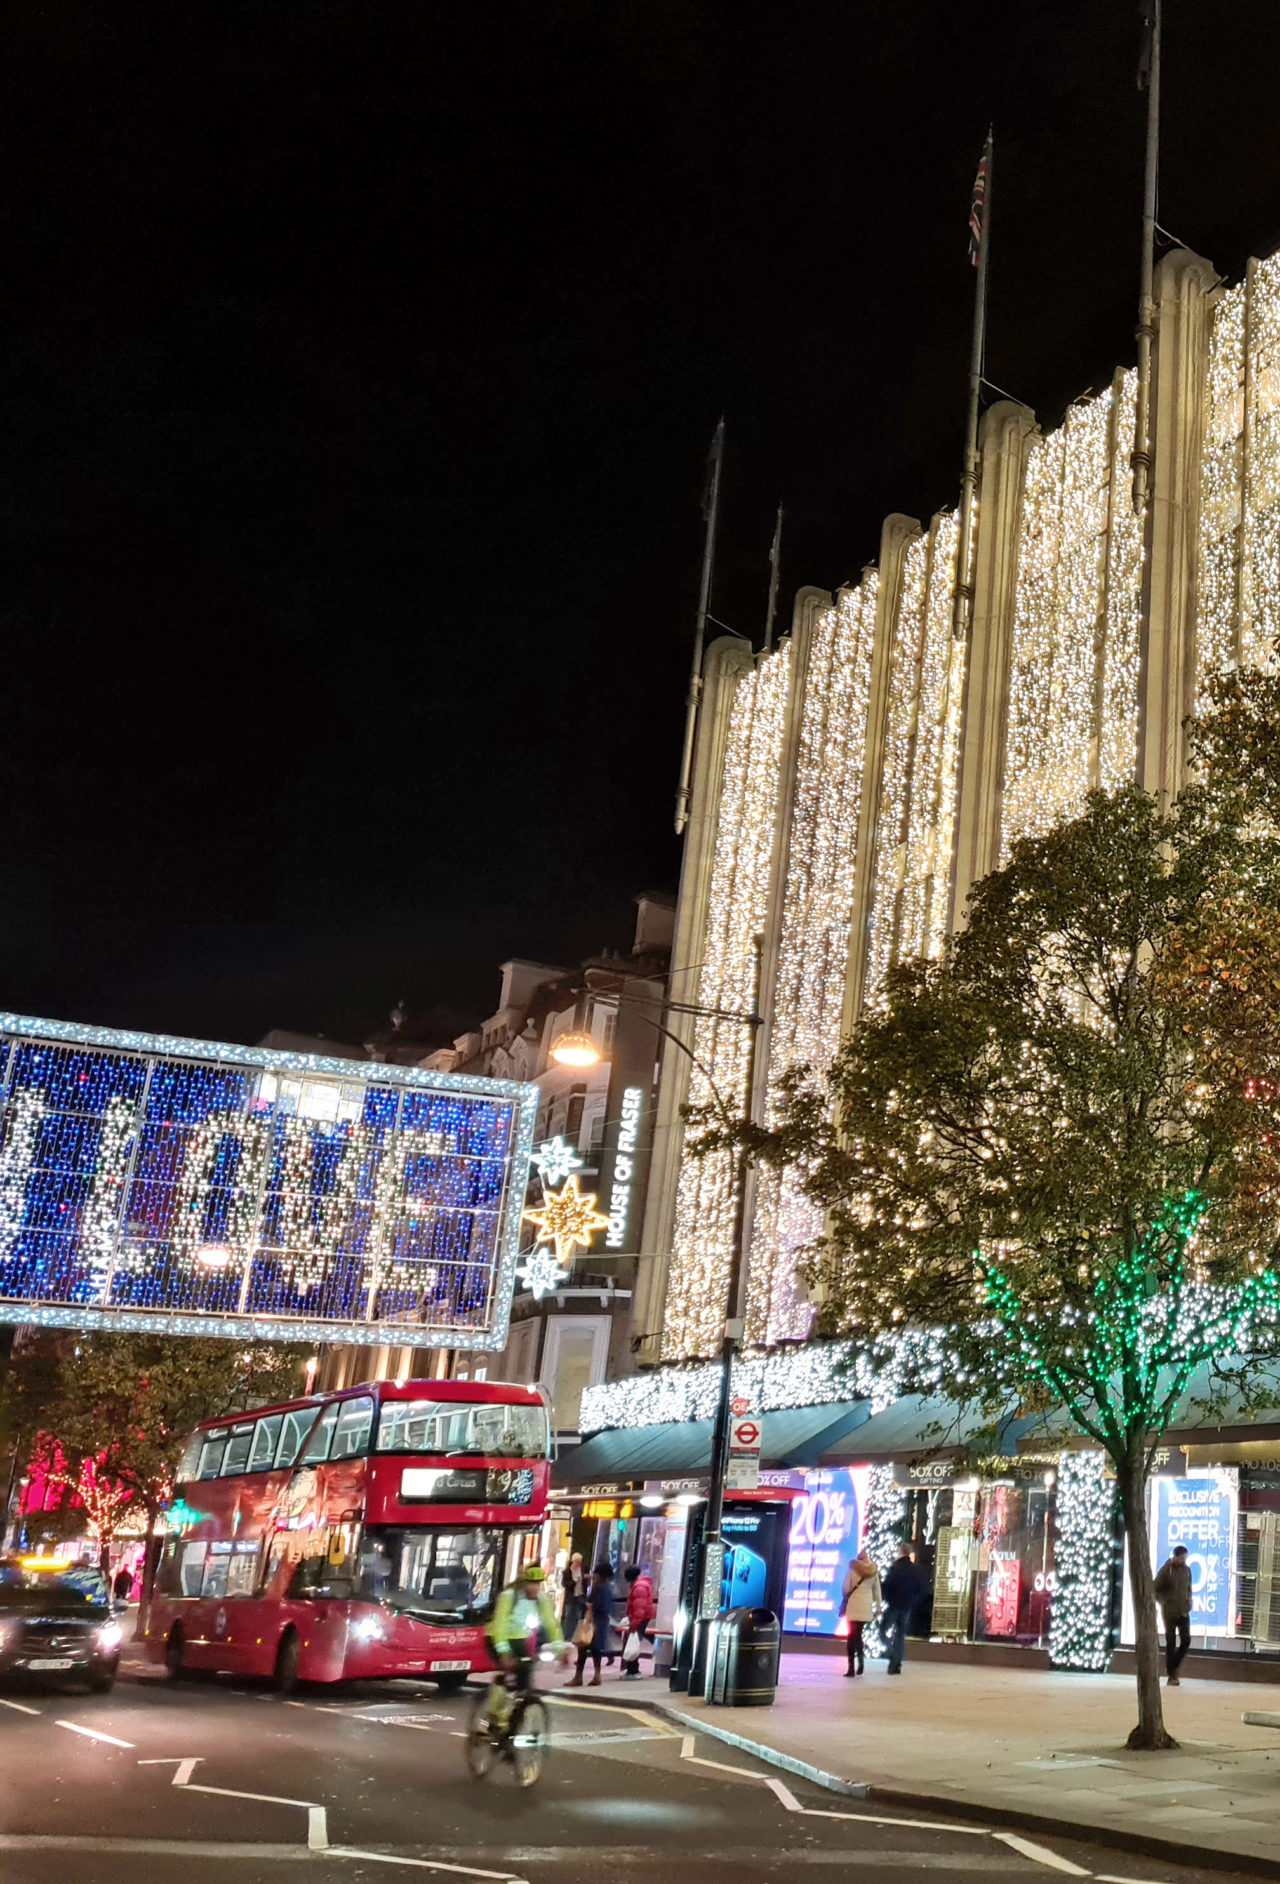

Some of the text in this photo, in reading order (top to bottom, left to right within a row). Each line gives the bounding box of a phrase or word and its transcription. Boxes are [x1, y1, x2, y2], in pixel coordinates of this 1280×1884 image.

[606, 1087, 642, 1248] HOUSE OF FRASER
[909, 1466, 932, 1478] 50%
[756, 1474, 790, 1487] 0% OFF
[919, 1477, 943, 1485] GIFTING
[1168, 1491, 1220, 1504] EXCLUSIVE
[788, 1490, 846, 1545] 20%
[1168, 1506, 1220, 1518] RECOGNITION
[1168, 1520, 1219, 1541] OFFER
[1186, 1553, 1218, 1593] 0%
